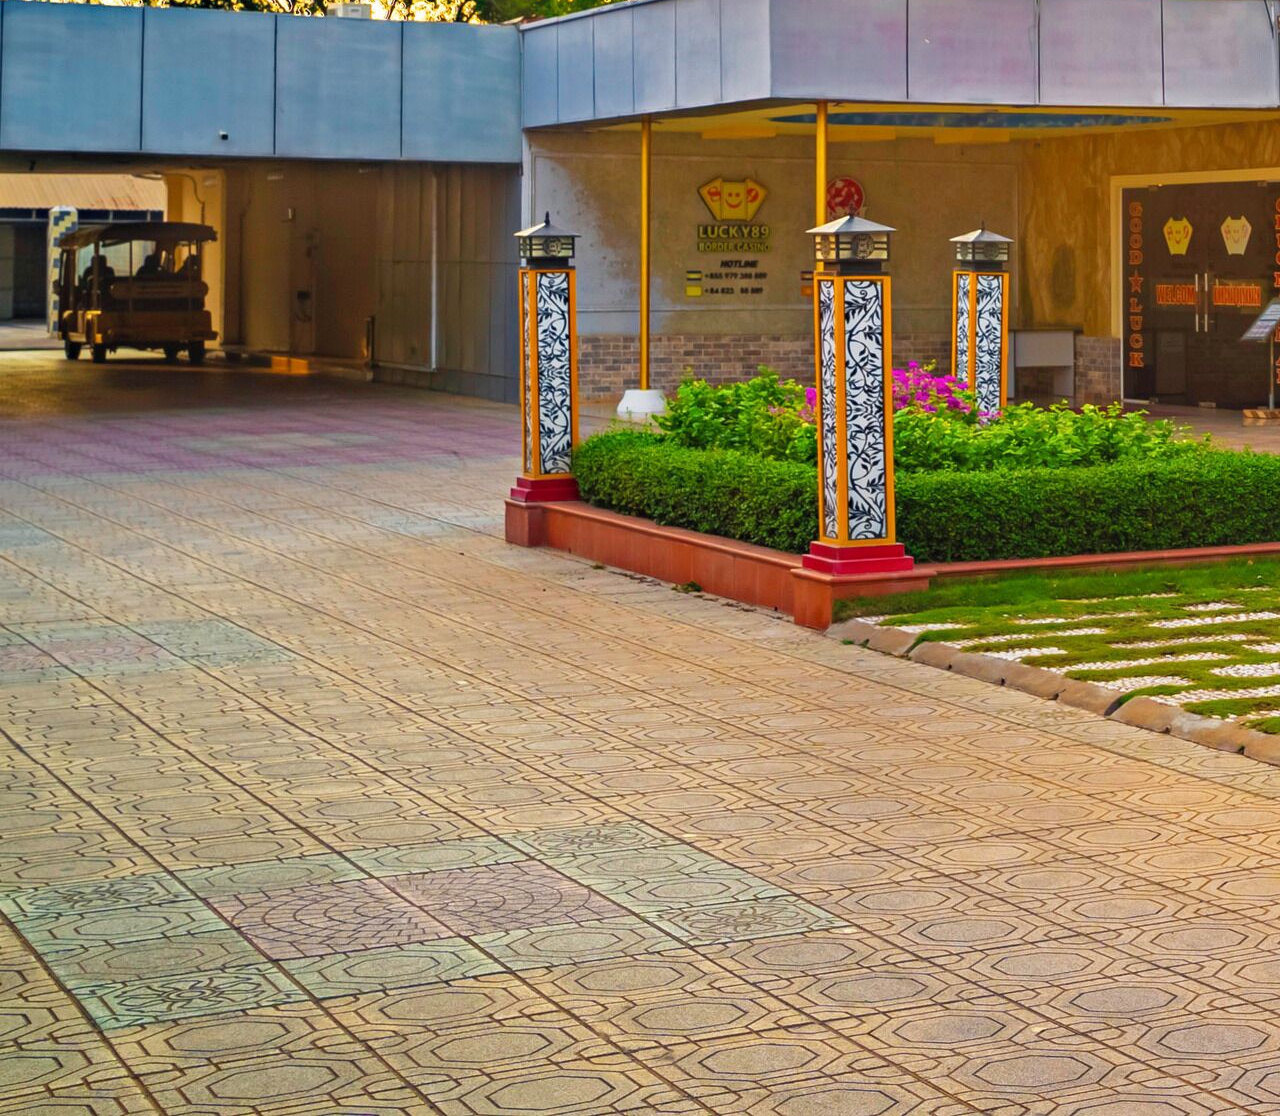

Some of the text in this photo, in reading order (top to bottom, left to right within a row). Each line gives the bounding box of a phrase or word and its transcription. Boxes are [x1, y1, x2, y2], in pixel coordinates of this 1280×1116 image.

[698, 225, 770, 239] LUCKY89
[698, 243, 769, 253] BORDER CASINO
[720, 260, 758, 268] HOTLINE
[1128, 201, 1145, 368] GOOD LUCK
